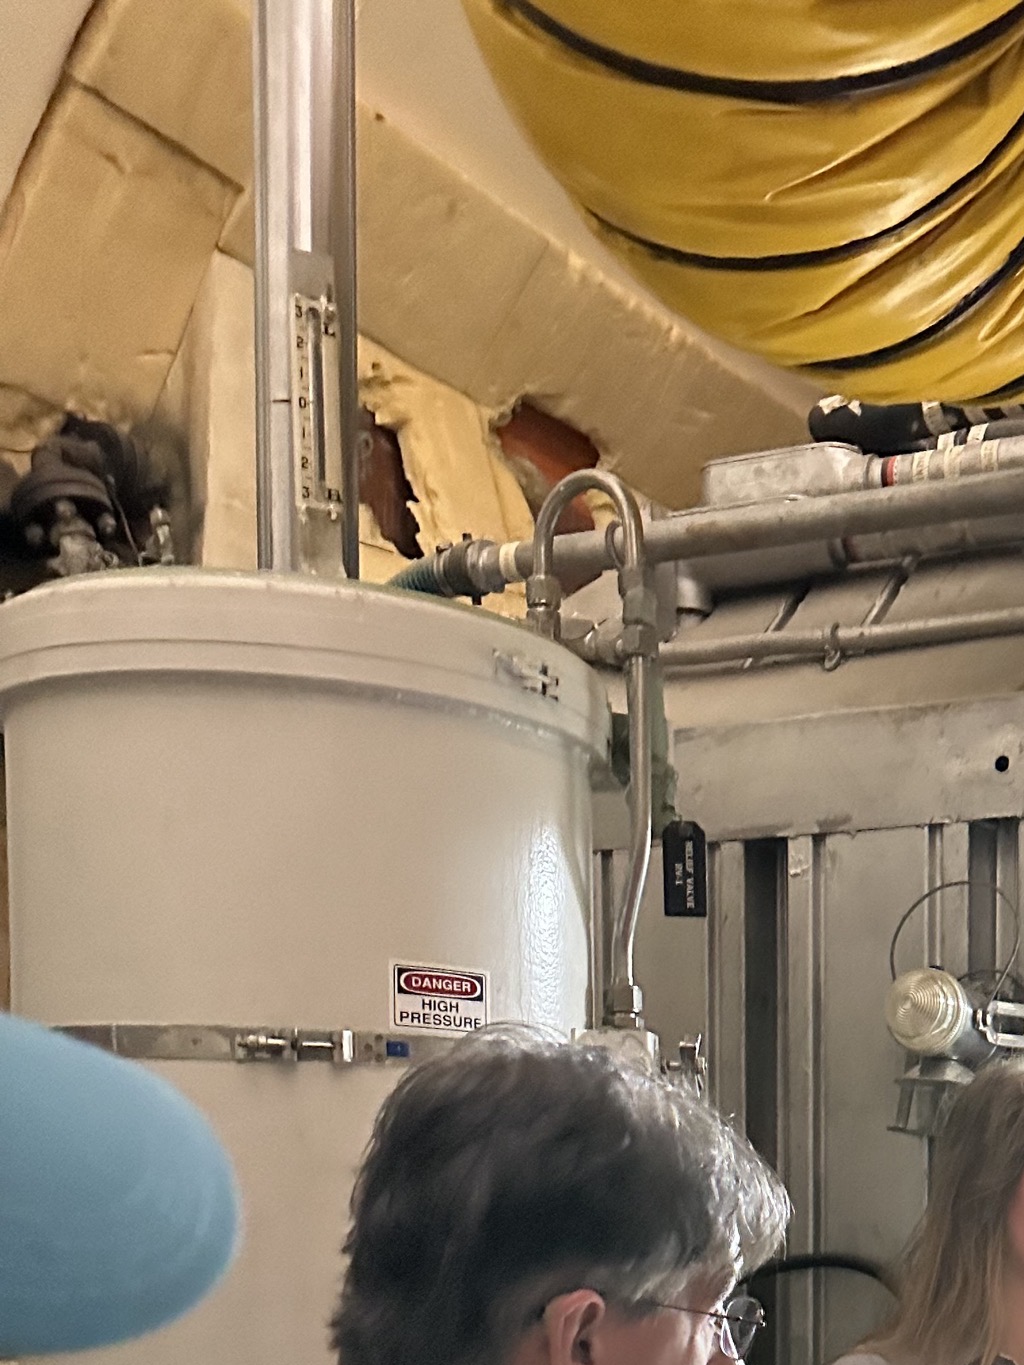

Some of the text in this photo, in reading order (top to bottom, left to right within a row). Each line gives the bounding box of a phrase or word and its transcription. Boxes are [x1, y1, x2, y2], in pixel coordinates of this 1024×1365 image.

[294, 305, 303, 318] 3
[296, 336, 304, 348] 2
[299, 396, 307, 408] 0
[301, 456, 309, 469] 2
[302, 486, 310, 499] 3
[686, 877, 695, 909] VALVE
[411, 976, 471, 993] DANGER
[421, 999, 459, 1013] HIGH
[400, 1010, 482, 1030] PRESSURE
